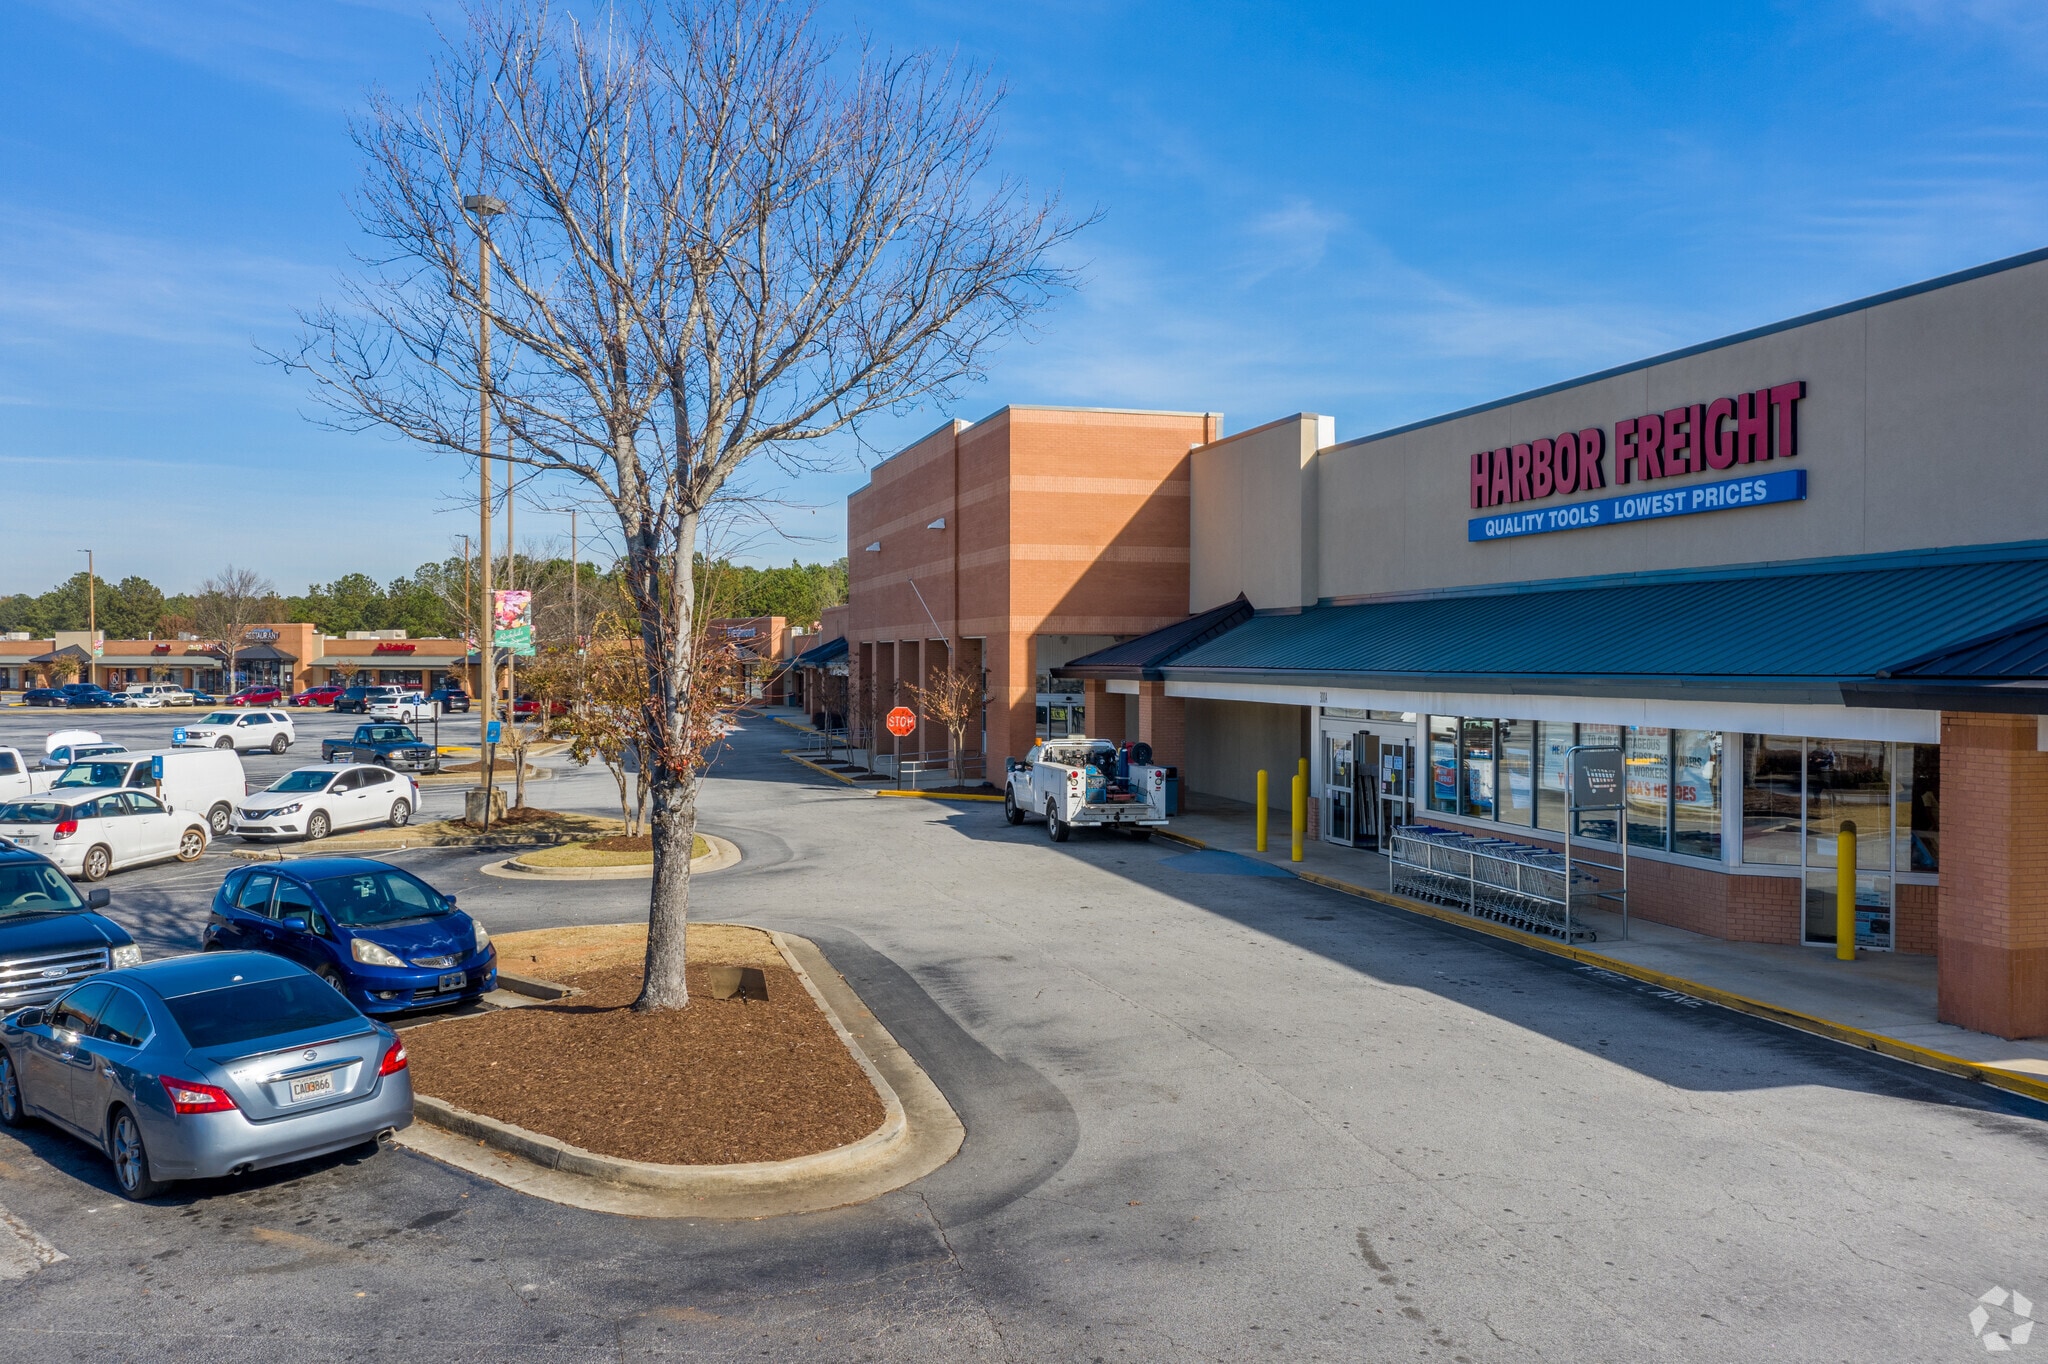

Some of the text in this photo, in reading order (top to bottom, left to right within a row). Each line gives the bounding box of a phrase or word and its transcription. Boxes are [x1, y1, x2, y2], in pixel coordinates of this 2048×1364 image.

[1470, 381, 1806, 508] HARBOR FREIGHT
[1485, 479, 1768, 537] QUALITY TOOLS LOWEST PRICES
[888, 715, 914, 728] STOP
[1654, 783, 1697, 802] HEOES
